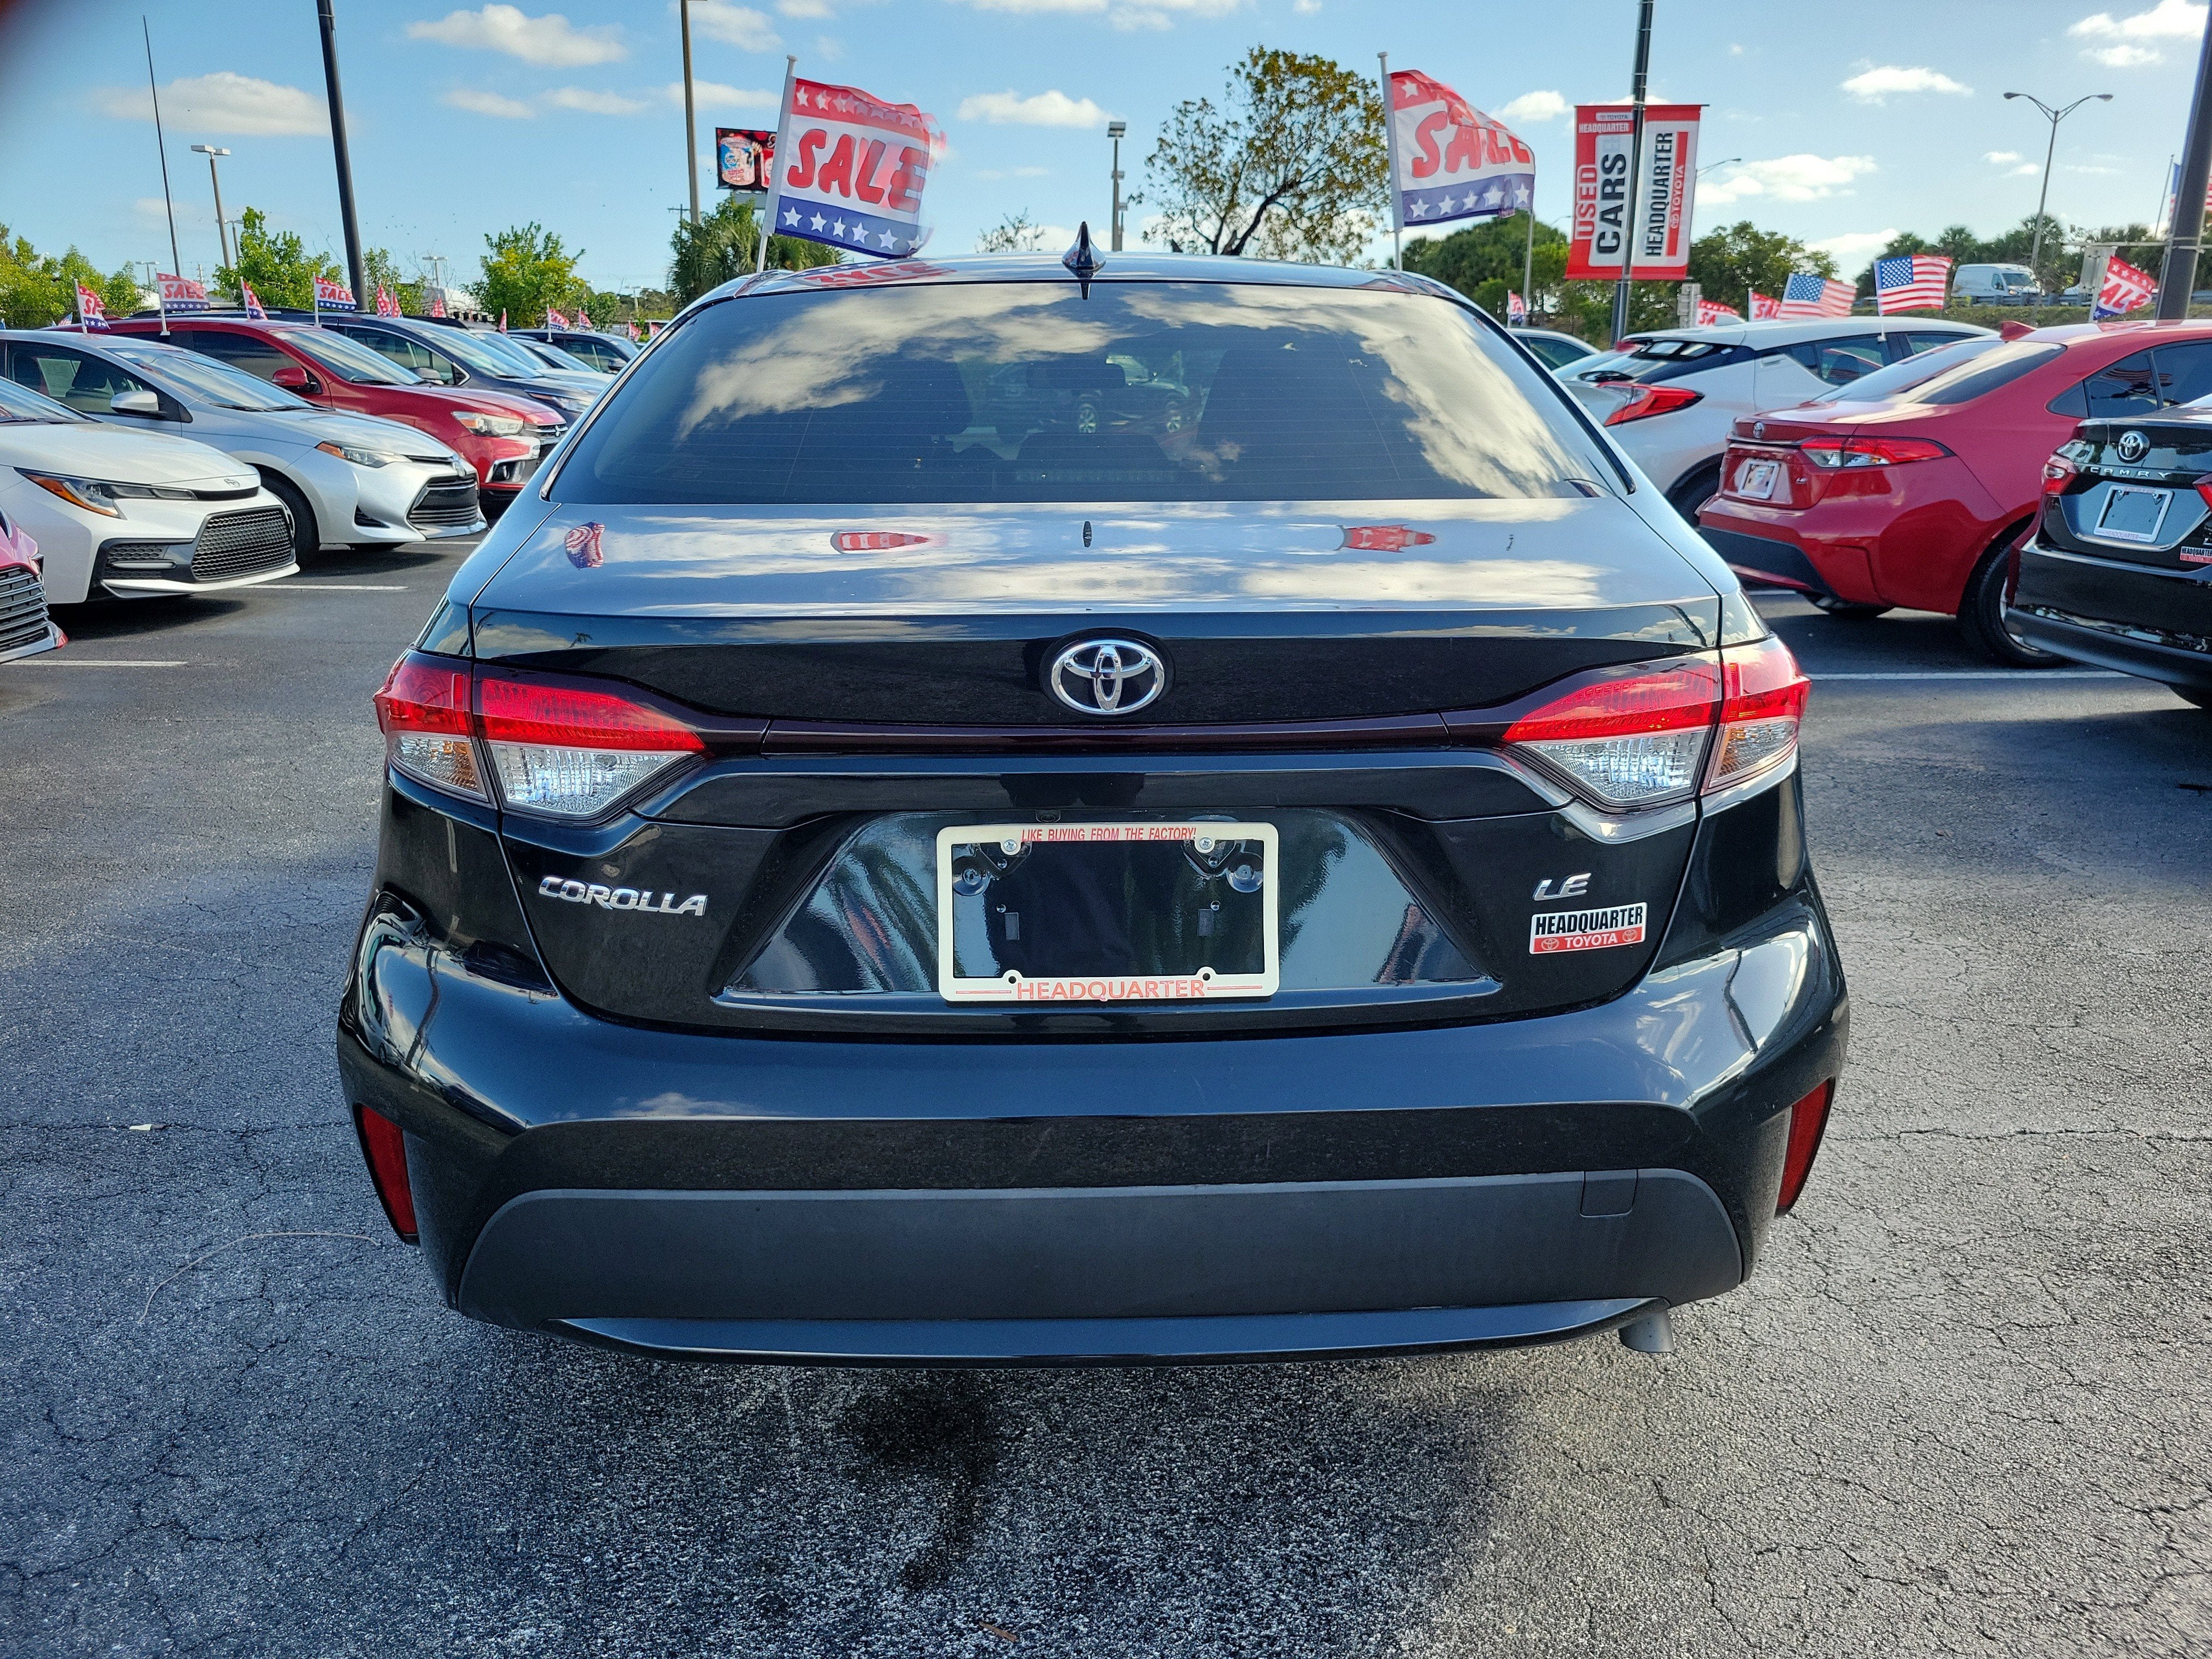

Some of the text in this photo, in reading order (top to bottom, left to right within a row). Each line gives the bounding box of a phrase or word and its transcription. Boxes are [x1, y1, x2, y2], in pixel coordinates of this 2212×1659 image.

[1578, 122, 1629, 133] HEADQUARTER
[787, 128, 929, 213] SALE
[1672, 165, 1685, 207] TOYOTA
[1577, 166, 1598, 239] USED
[1596, 154, 1627, 254] CARS
[1644, 132, 1673, 257] HEADQUARTER
[2098, 276, 2148, 311] ALE
[2090, 467, 2171, 478] CAMRY
[1021, 827, 1197, 841] LIKE BUYING FROM THE FACTORY!
[539, 877, 708, 916] COROLLA
[1533, 872, 1592, 901] LE
[1535, 906, 1643, 935] HEADQUARTER
[1565, 933, 1618, 948] TOYOTA
[1018, 980, 1205, 1001] HEADQUARTER
